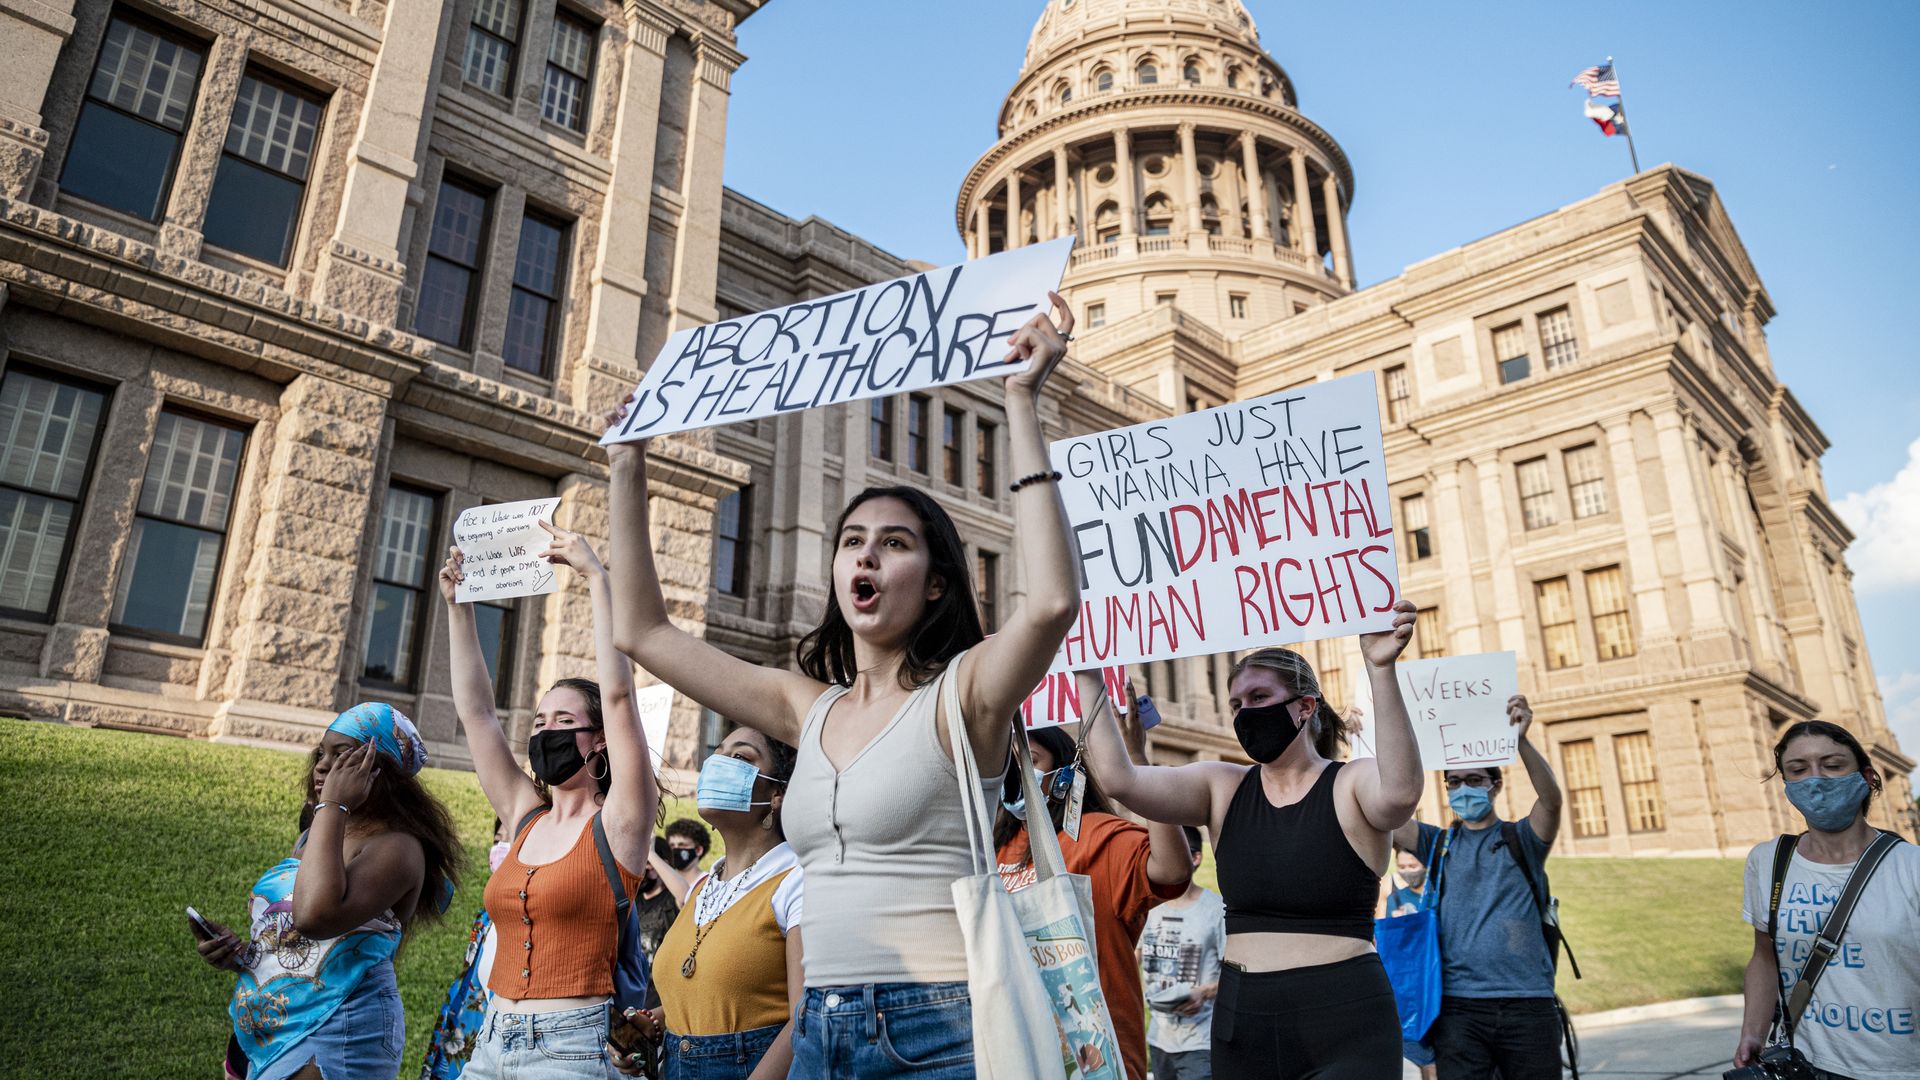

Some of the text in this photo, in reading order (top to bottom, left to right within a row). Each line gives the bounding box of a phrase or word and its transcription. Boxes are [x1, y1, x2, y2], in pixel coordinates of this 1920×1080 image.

[662, 265, 963, 383] ABORTION
[619, 303, 1038, 435] IS HEALTHCARE
[1066, 396, 1306, 478] GIRLS JUST
[1088, 425, 1370, 512] WANNA HAVE
[529, 504, 549, 517] NOT
[1072, 478, 1393, 590] FUNDAMENTAL
[470, 580, 524, 593] from abortions
[473, 568, 486, 578] end
[491, 565, 498, 576] of
[1065, 545, 1395, 666] HUMAN RIGHTS
[1771, 881, 1782, 911] Nikon
[1787, 882, 1842, 906] AM
[1803, 1000, 1915, 1035] HOICE
